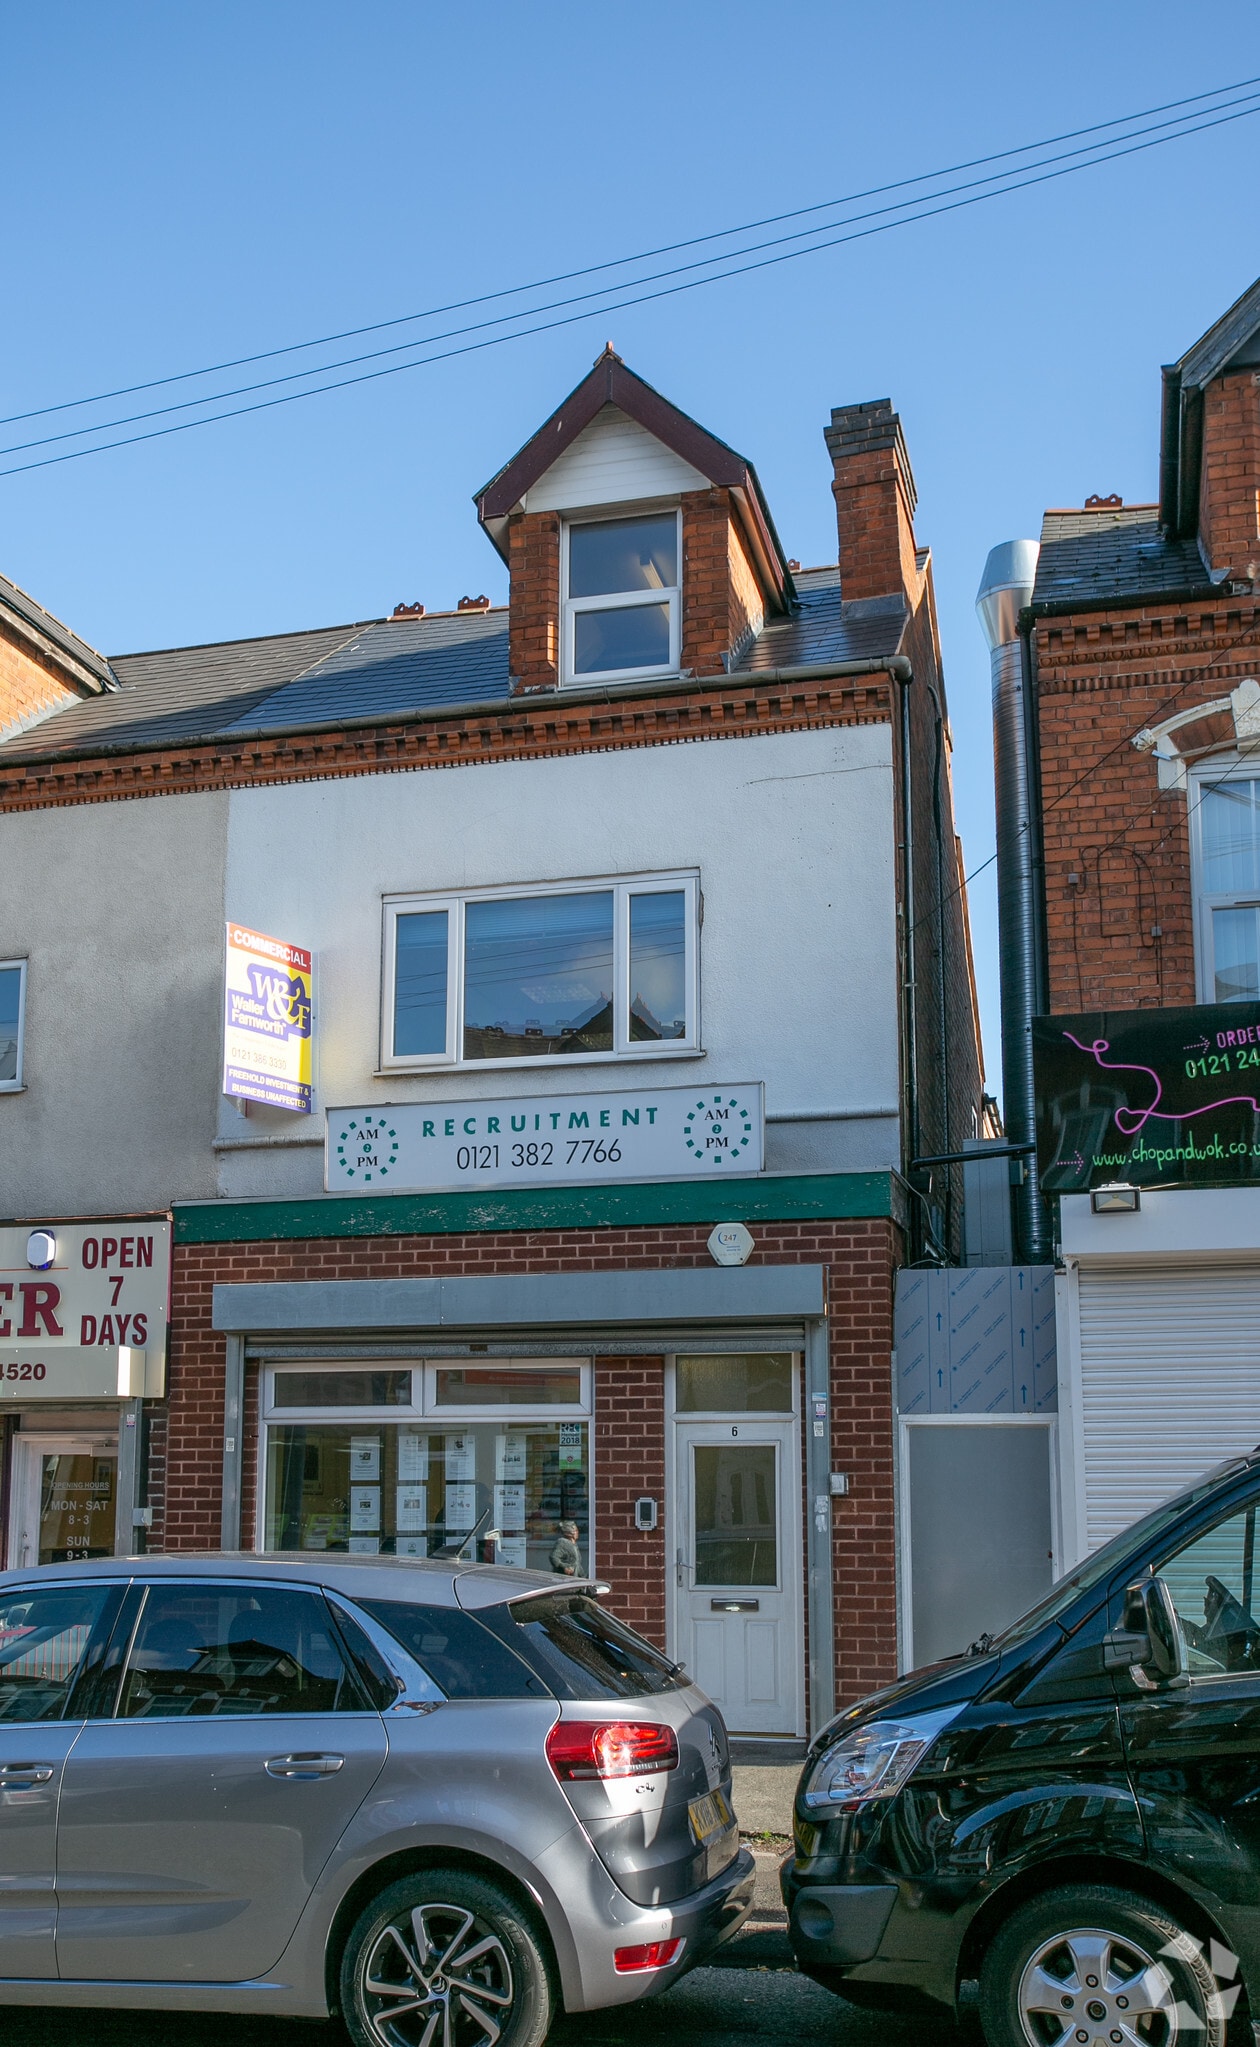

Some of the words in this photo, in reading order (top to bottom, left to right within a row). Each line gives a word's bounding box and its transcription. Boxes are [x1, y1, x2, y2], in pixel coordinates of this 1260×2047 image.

[233, 929, 307, 967] COMMERCIAL
[231, 993, 265, 1017] Waller
[231, 1009, 285, 1036] Farnworth
[1185, 1053, 1230, 1079] 0121
[229, 1069, 265, 1085] FREEHOLD
[303, 1087, 310, 1097] &
[231, 1083, 266, 1099] BUSINESS
[704, 1108, 729, 1121] AM
[422, 1107, 658, 1137] RECRUITMENT
[356, 1128, 379, 1141] AM
[705, 1136, 729, 1149] PM
[456, 1144, 499, 1170] 0121
[511, 1142, 554, 1168] 382
[565, 1138, 622, 1165] 7766
[357, 1155, 378, 1168] PM
[723, 1233, 737, 1242] 247
[81, 1236, 154, 1270] OPEN
[108, 1275, 124, 1307] 7
[80, 1313, 148, 1346] DAYS
[731, 1425, 738, 1437] 6
[53, 1481, 84, 1489] OPENING
[84, 1481, 110, 1489] HOURS
[51, 1500, 77, 1511] MON
[85, 1500, 108, 1511] SAT
[68, 1514, 75, 1525] 8
[82, 1514, 90, 1525] 3
[66, 1535, 90, 1547] SUN
[66, 1550, 73, 1561] 9
[82, 1550, 88, 1560] 3
[635, 1782, 655, 1794] C4
